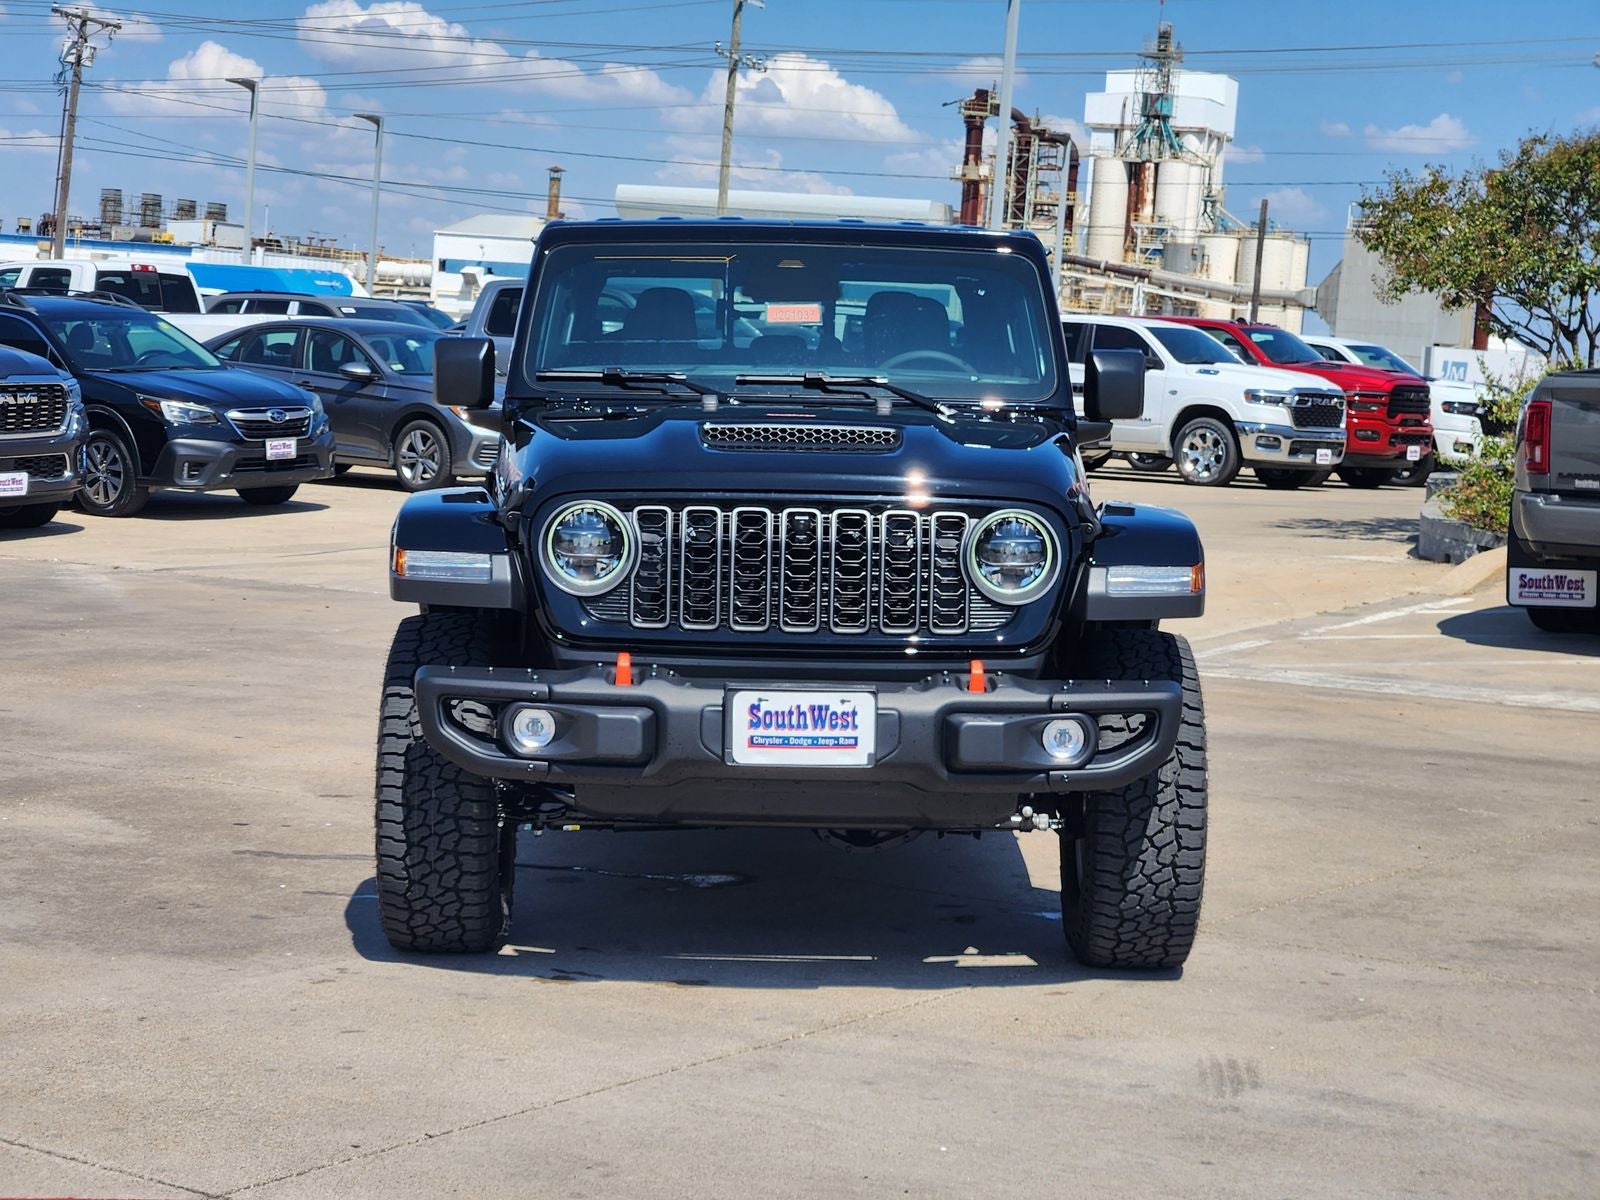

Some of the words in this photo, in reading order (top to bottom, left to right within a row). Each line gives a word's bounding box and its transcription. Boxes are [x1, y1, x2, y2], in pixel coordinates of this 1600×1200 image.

[0, 392, 38, 404] AM
[753, 736, 783, 745] Chrysler
[789, 736, 812, 746] Dodge
[817, 737, 835, 746] Jeep
[839, 737, 855, 745] Ram
